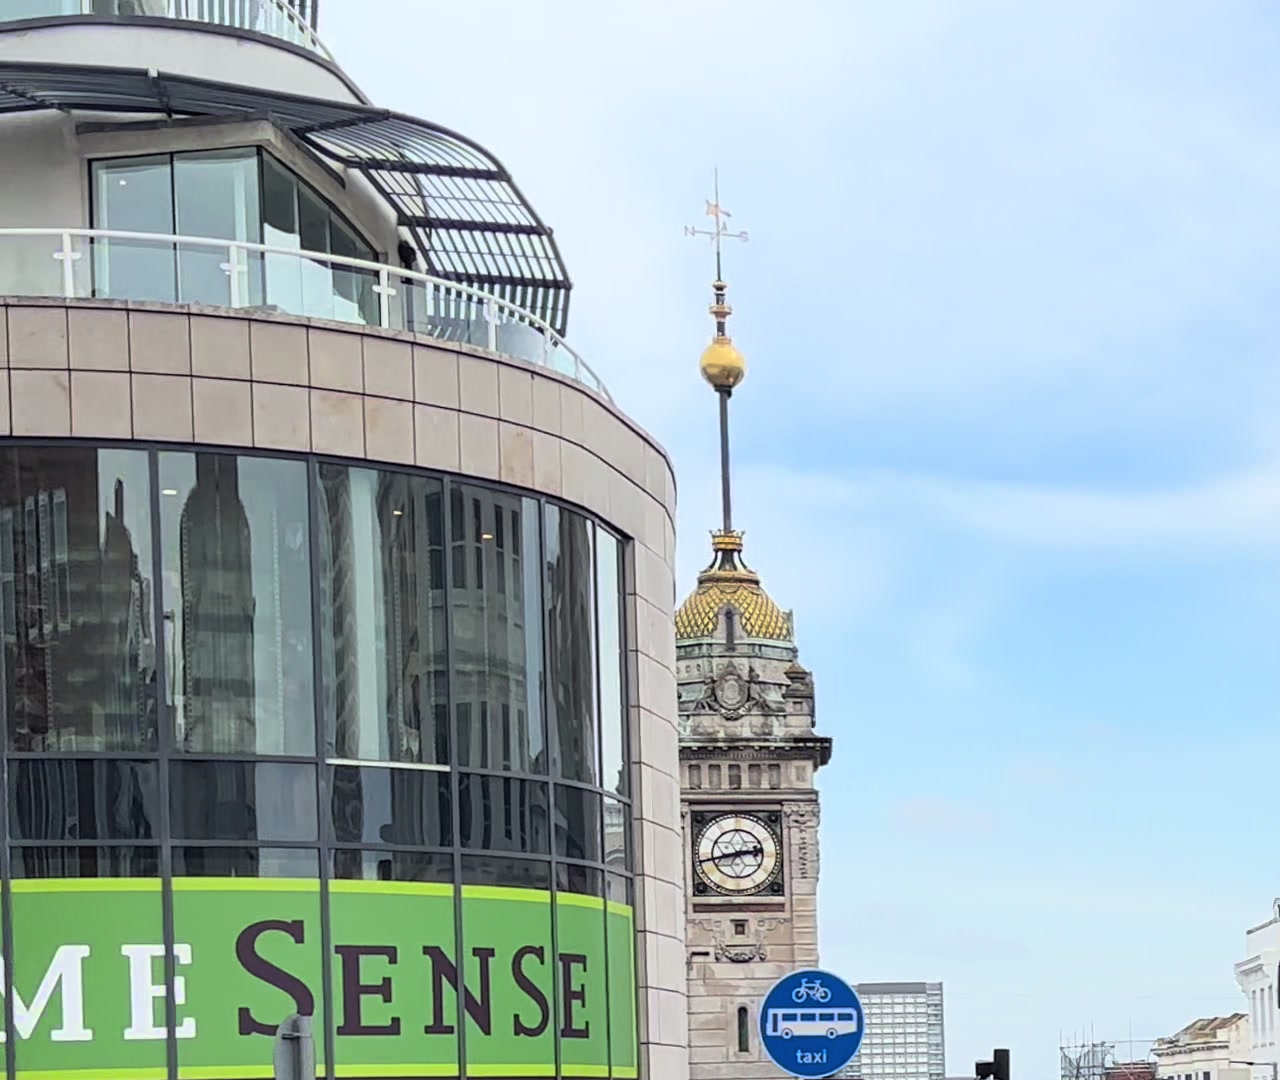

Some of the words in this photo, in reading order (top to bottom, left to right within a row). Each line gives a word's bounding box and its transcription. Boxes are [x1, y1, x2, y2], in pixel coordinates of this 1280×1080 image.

[0, 943, 196, 1042] ME
[235, 919, 590, 1039] SENSE
[796, 1048, 827, 1064] taxi
